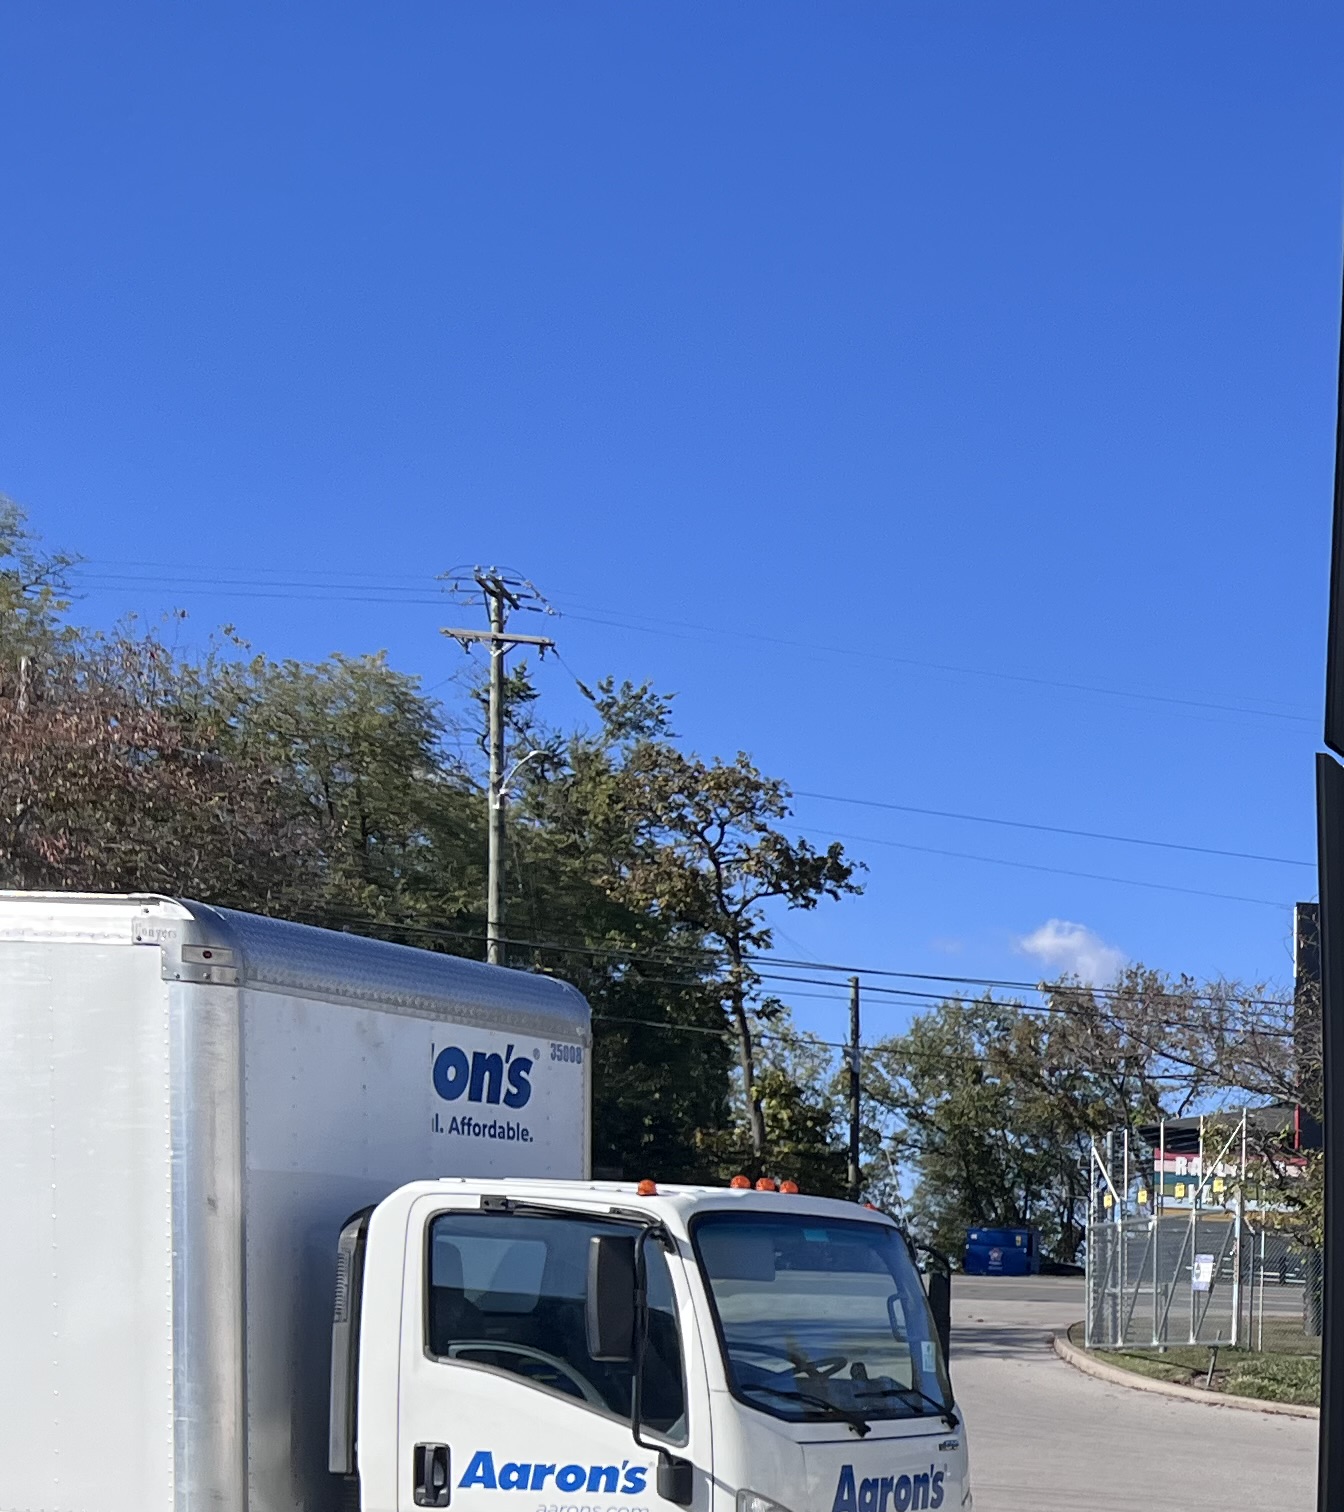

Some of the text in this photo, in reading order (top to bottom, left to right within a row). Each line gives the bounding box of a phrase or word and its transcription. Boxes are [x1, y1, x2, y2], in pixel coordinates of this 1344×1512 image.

[432, 1043, 534, 1109] on's
[448, 1115, 534, 1143] Affordable.
[457, 1451, 649, 1494] Aaron's
